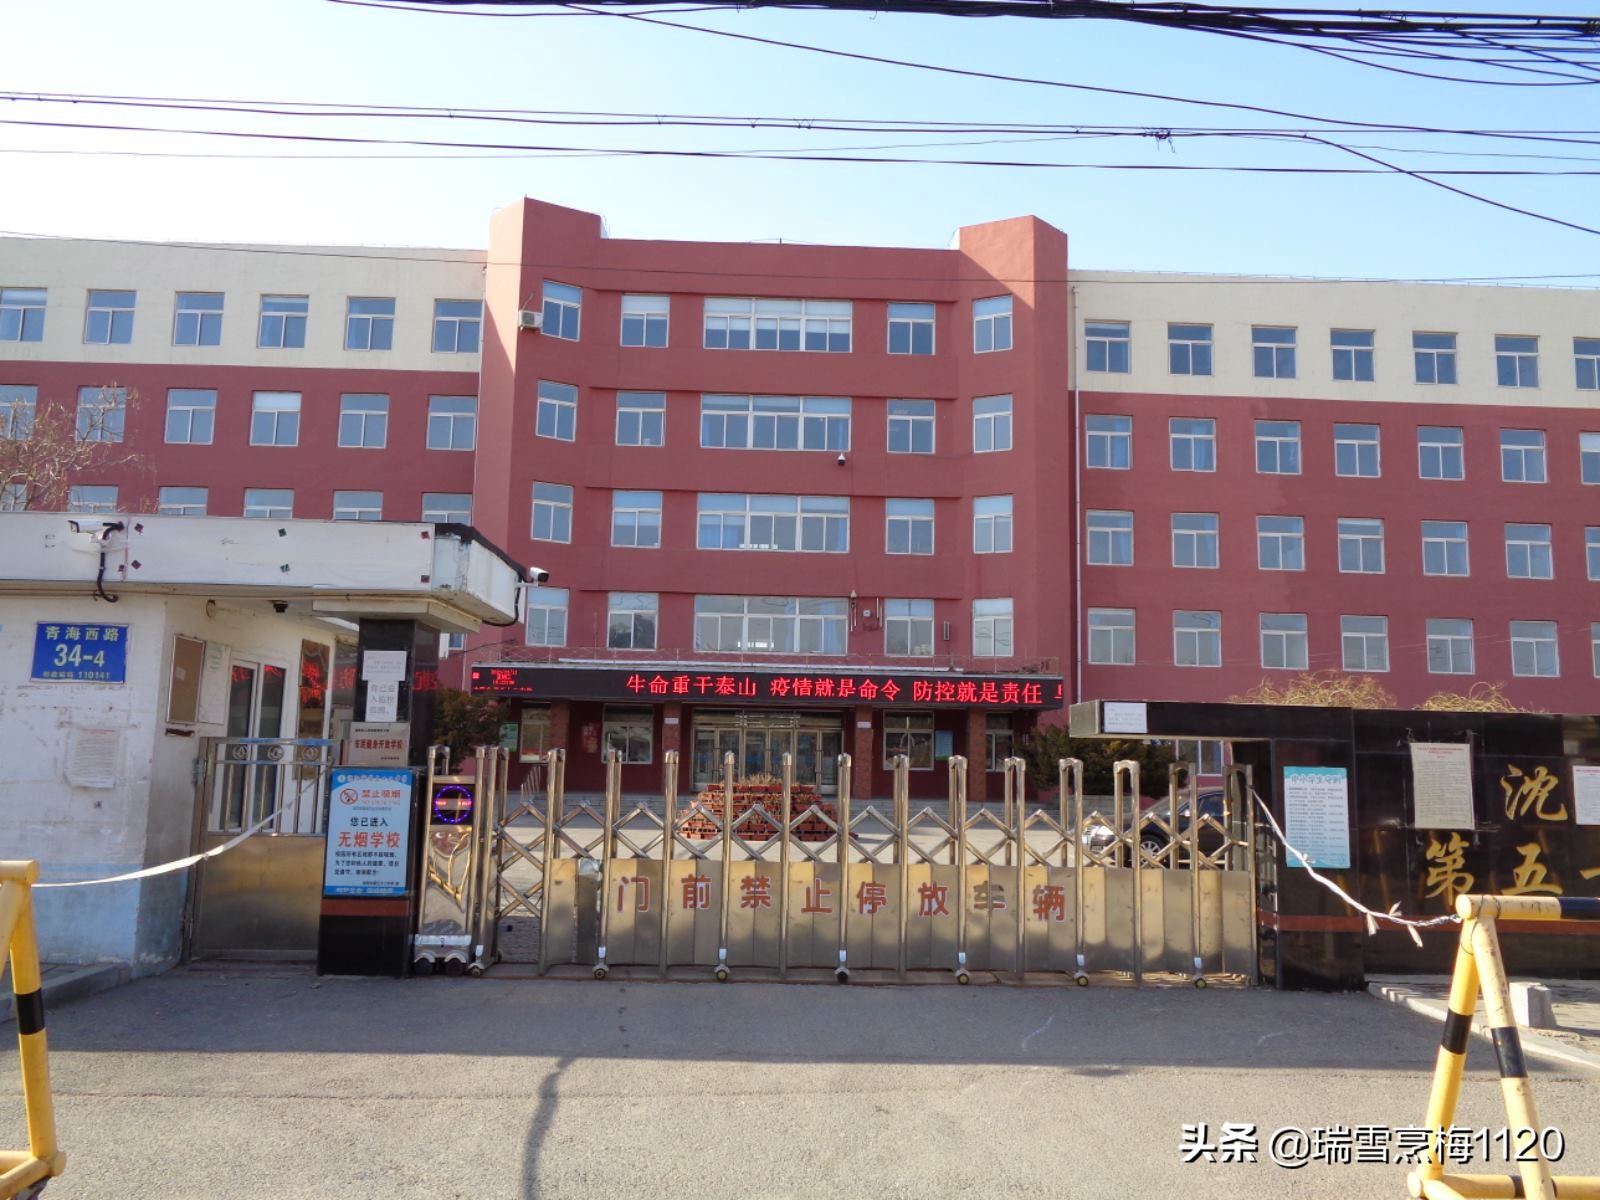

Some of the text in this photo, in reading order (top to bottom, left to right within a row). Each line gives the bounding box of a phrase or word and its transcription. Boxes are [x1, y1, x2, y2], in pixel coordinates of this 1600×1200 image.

[45, 626, 119, 641] 青海西路
[54, 643, 105, 667] 34-4
[769, 677, 901, 701] 疫情就是命令
[913, 680, 1043, 704] 防控就是责任
[1500, 764, 1568, 821] 沈
[338, 831, 400, 848] 无烟学校
[617, 874, 1066, 923] 门前禁止停放车辆
